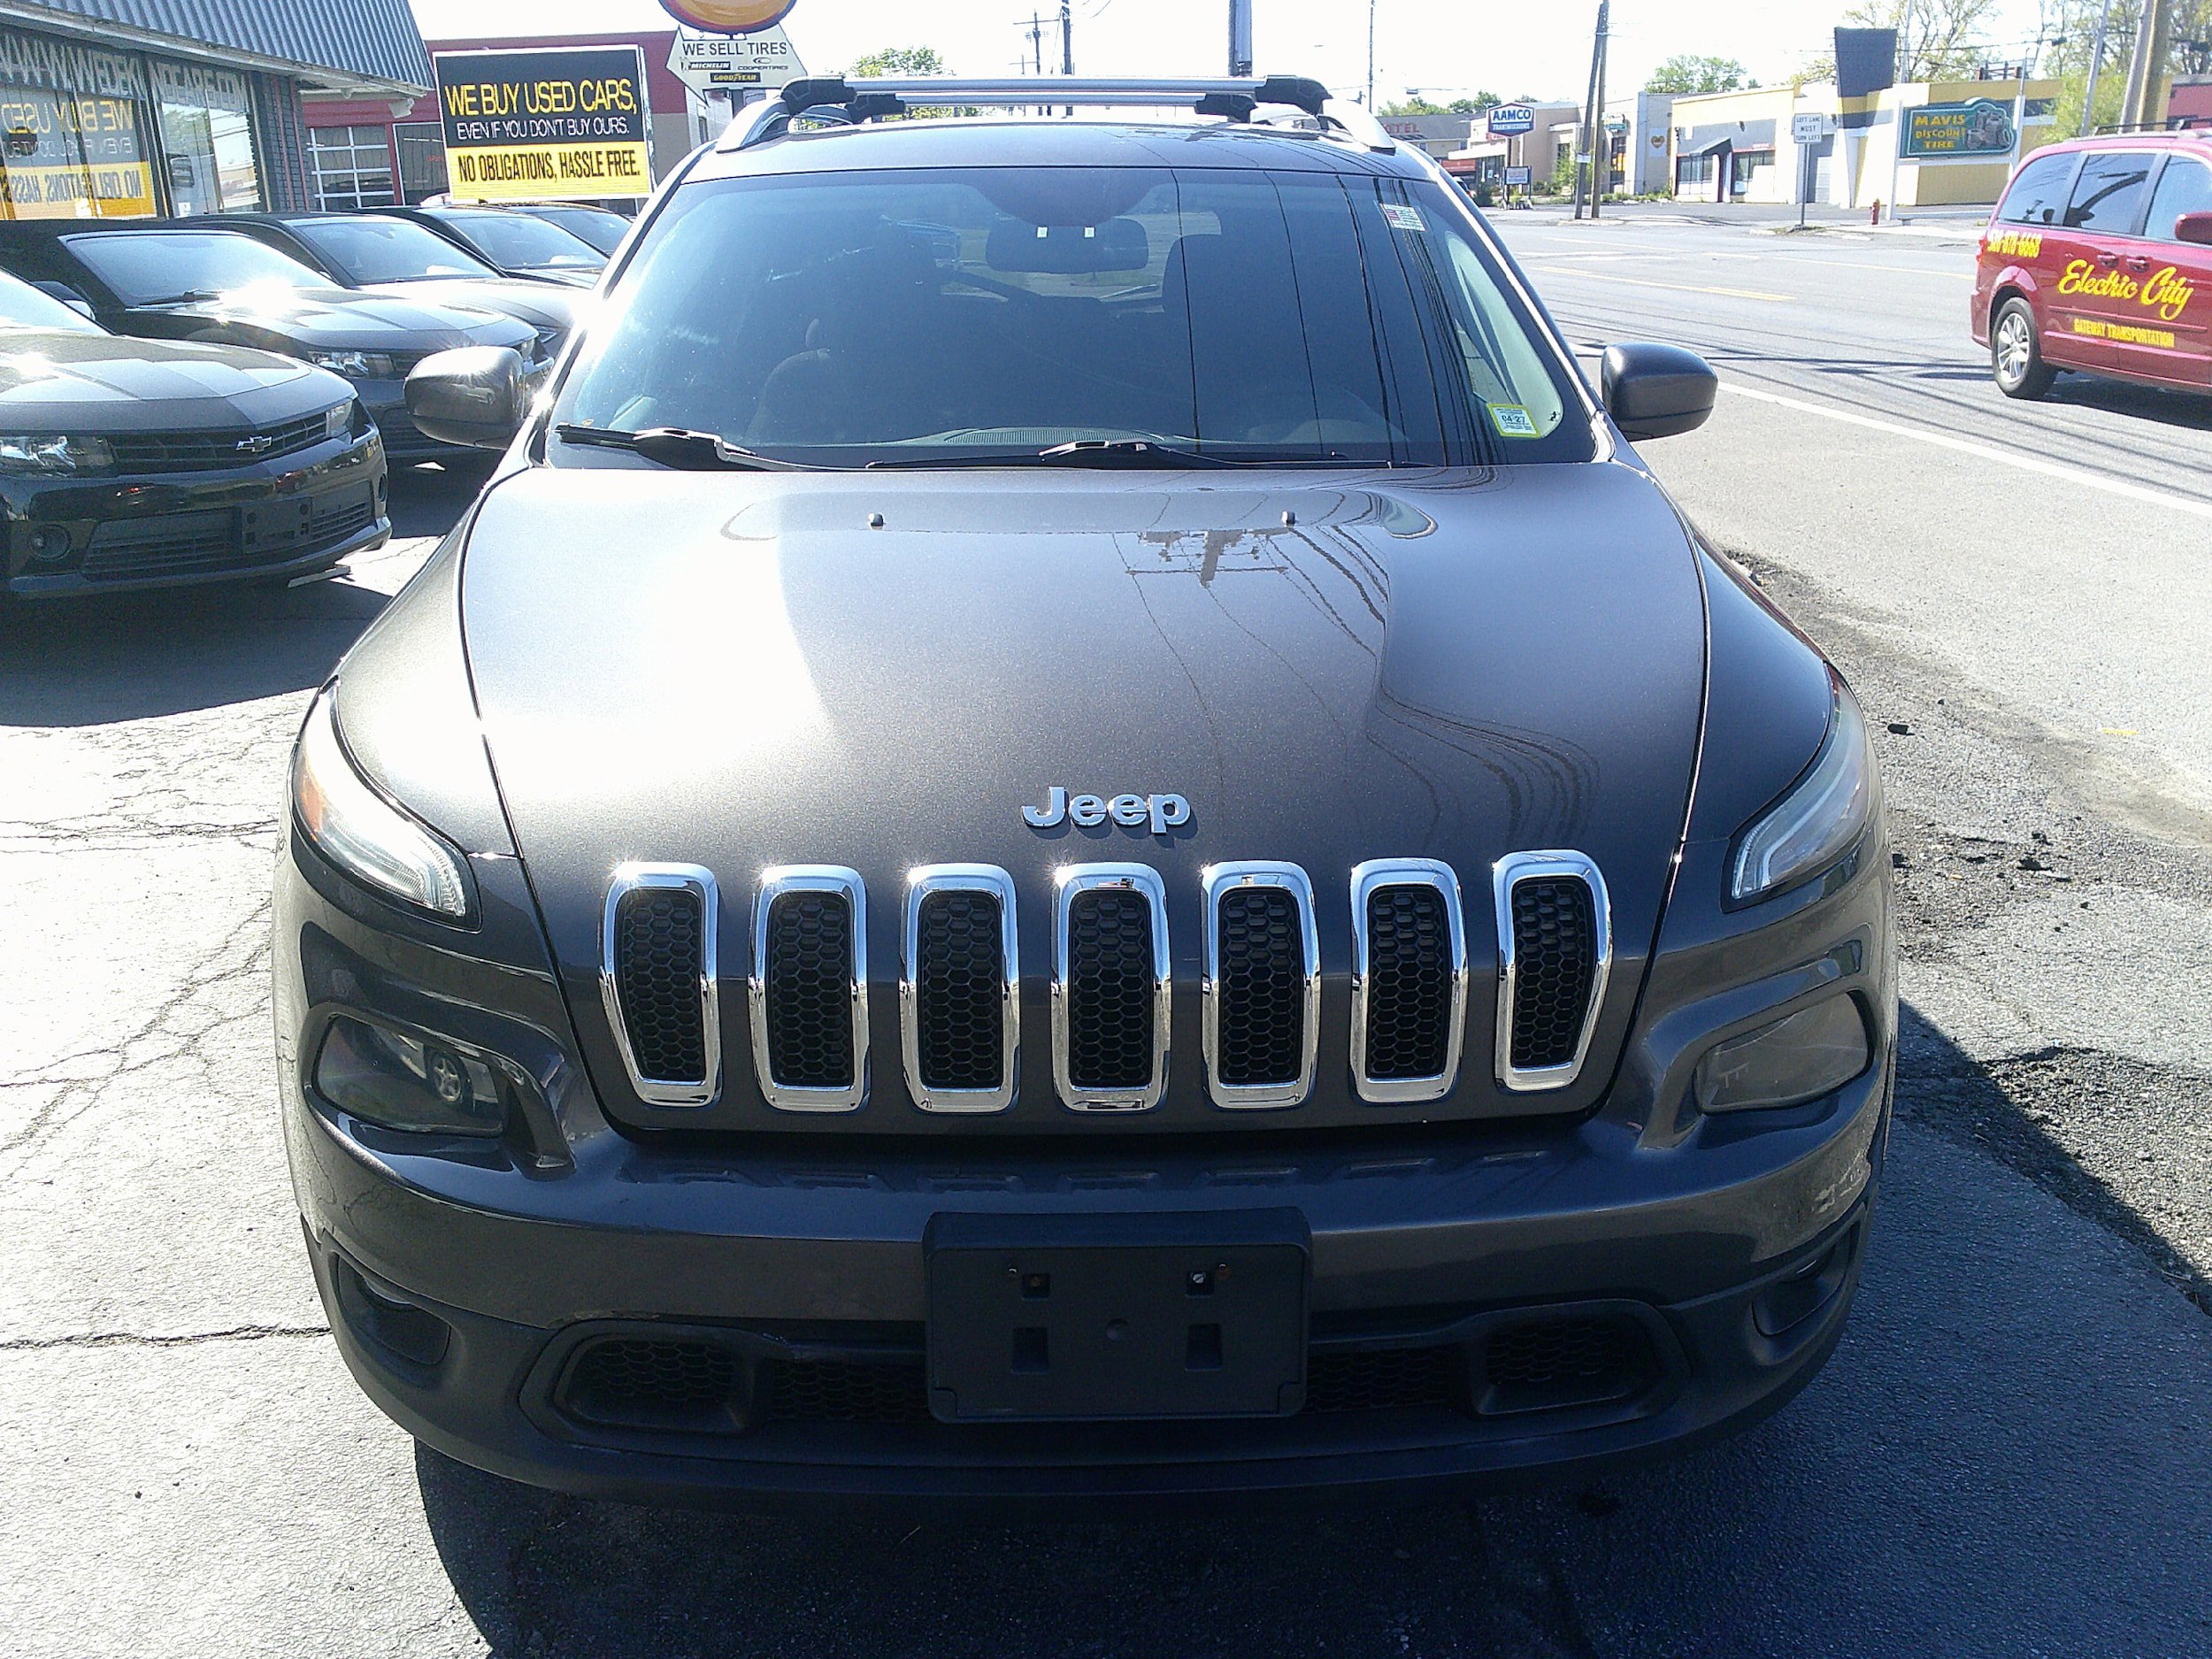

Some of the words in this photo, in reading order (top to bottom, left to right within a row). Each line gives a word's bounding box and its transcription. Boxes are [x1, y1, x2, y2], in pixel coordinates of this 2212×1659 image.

[682, 42, 705, 56] WE
[709, 42, 743, 55] SELL
[747, 42, 787, 55] TIRES
[444, 84, 479, 116] WE
[480, 82, 519, 115] BUY
[524, 81, 576, 113] USED
[580, 78, 637, 114] CARS,
[1492, 109, 1531, 121] AAMCO
[1915, 114, 1966, 127] MAVIS
[457, 120, 489, 140] EVEN
[489, 119, 501, 139] IF
[503, 119, 527, 138] YOU
[530, 118, 565, 137] DON'T
[567, 117, 591, 136] BUY
[593, 116, 629, 134] OURS.
[1916, 127, 1966, 139] DISCOUNT
[1924, 140, 1955, 150] TIRE
[457, 154, 476, 182] NO
[478, 151, 557, 183] OBLIGATIONS,
[558, 150, 604, 179] HASSLE
[606, 150, 641, 177] FREE.
[2058, 259, 2138, 299] Electric
[2140, 266, 2194, 320] City
[1022, 786, 1190, 834] Jeep
